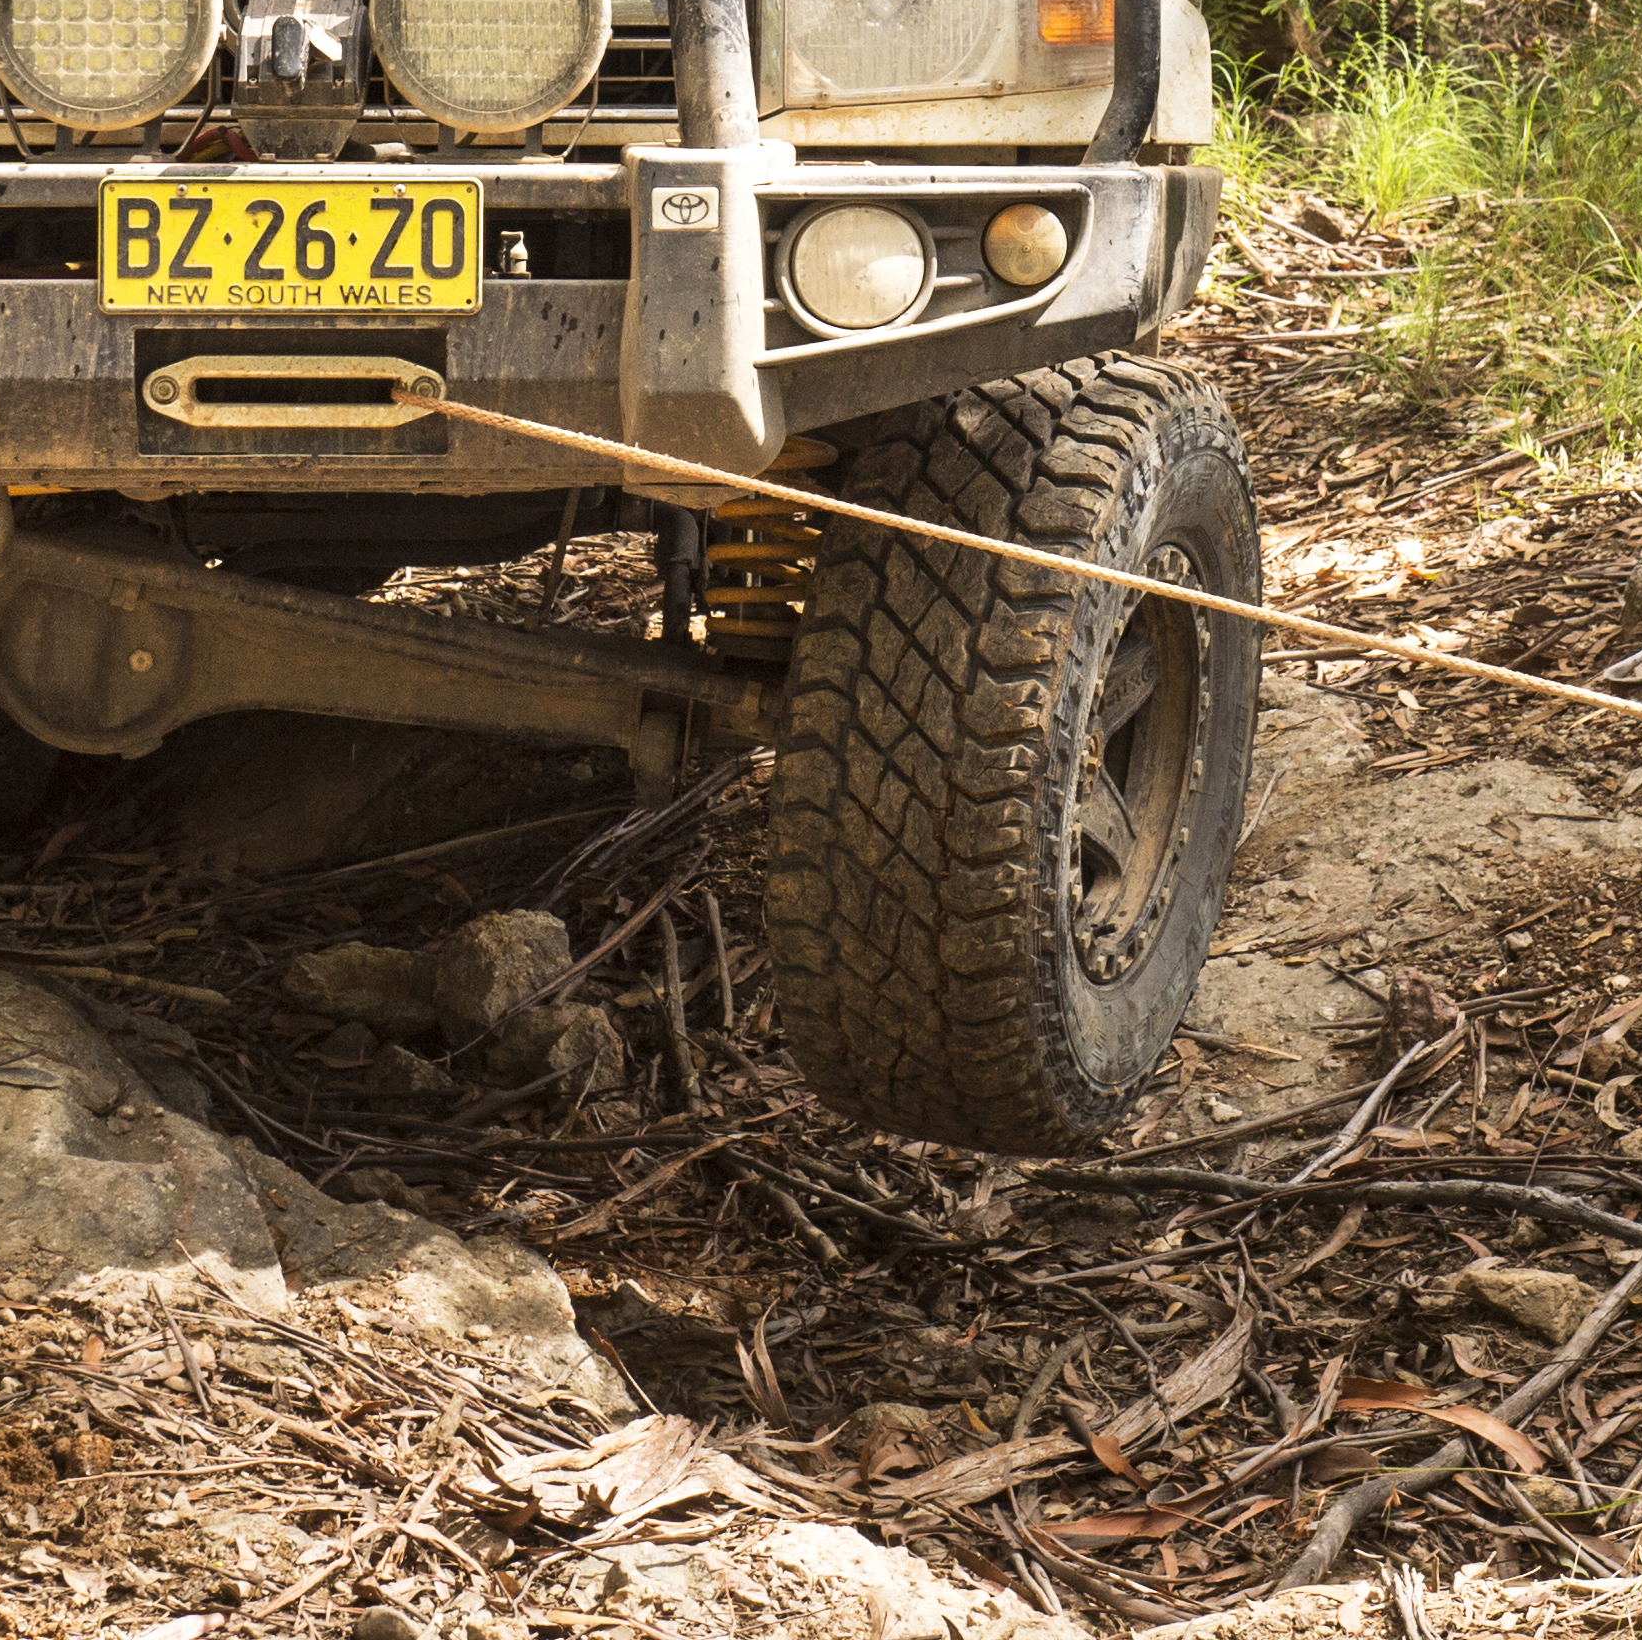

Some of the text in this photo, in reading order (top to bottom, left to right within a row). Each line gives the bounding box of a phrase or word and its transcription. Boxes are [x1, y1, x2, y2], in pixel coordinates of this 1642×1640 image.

[148, 284, 433, 306] NEW SOUTH WALES
